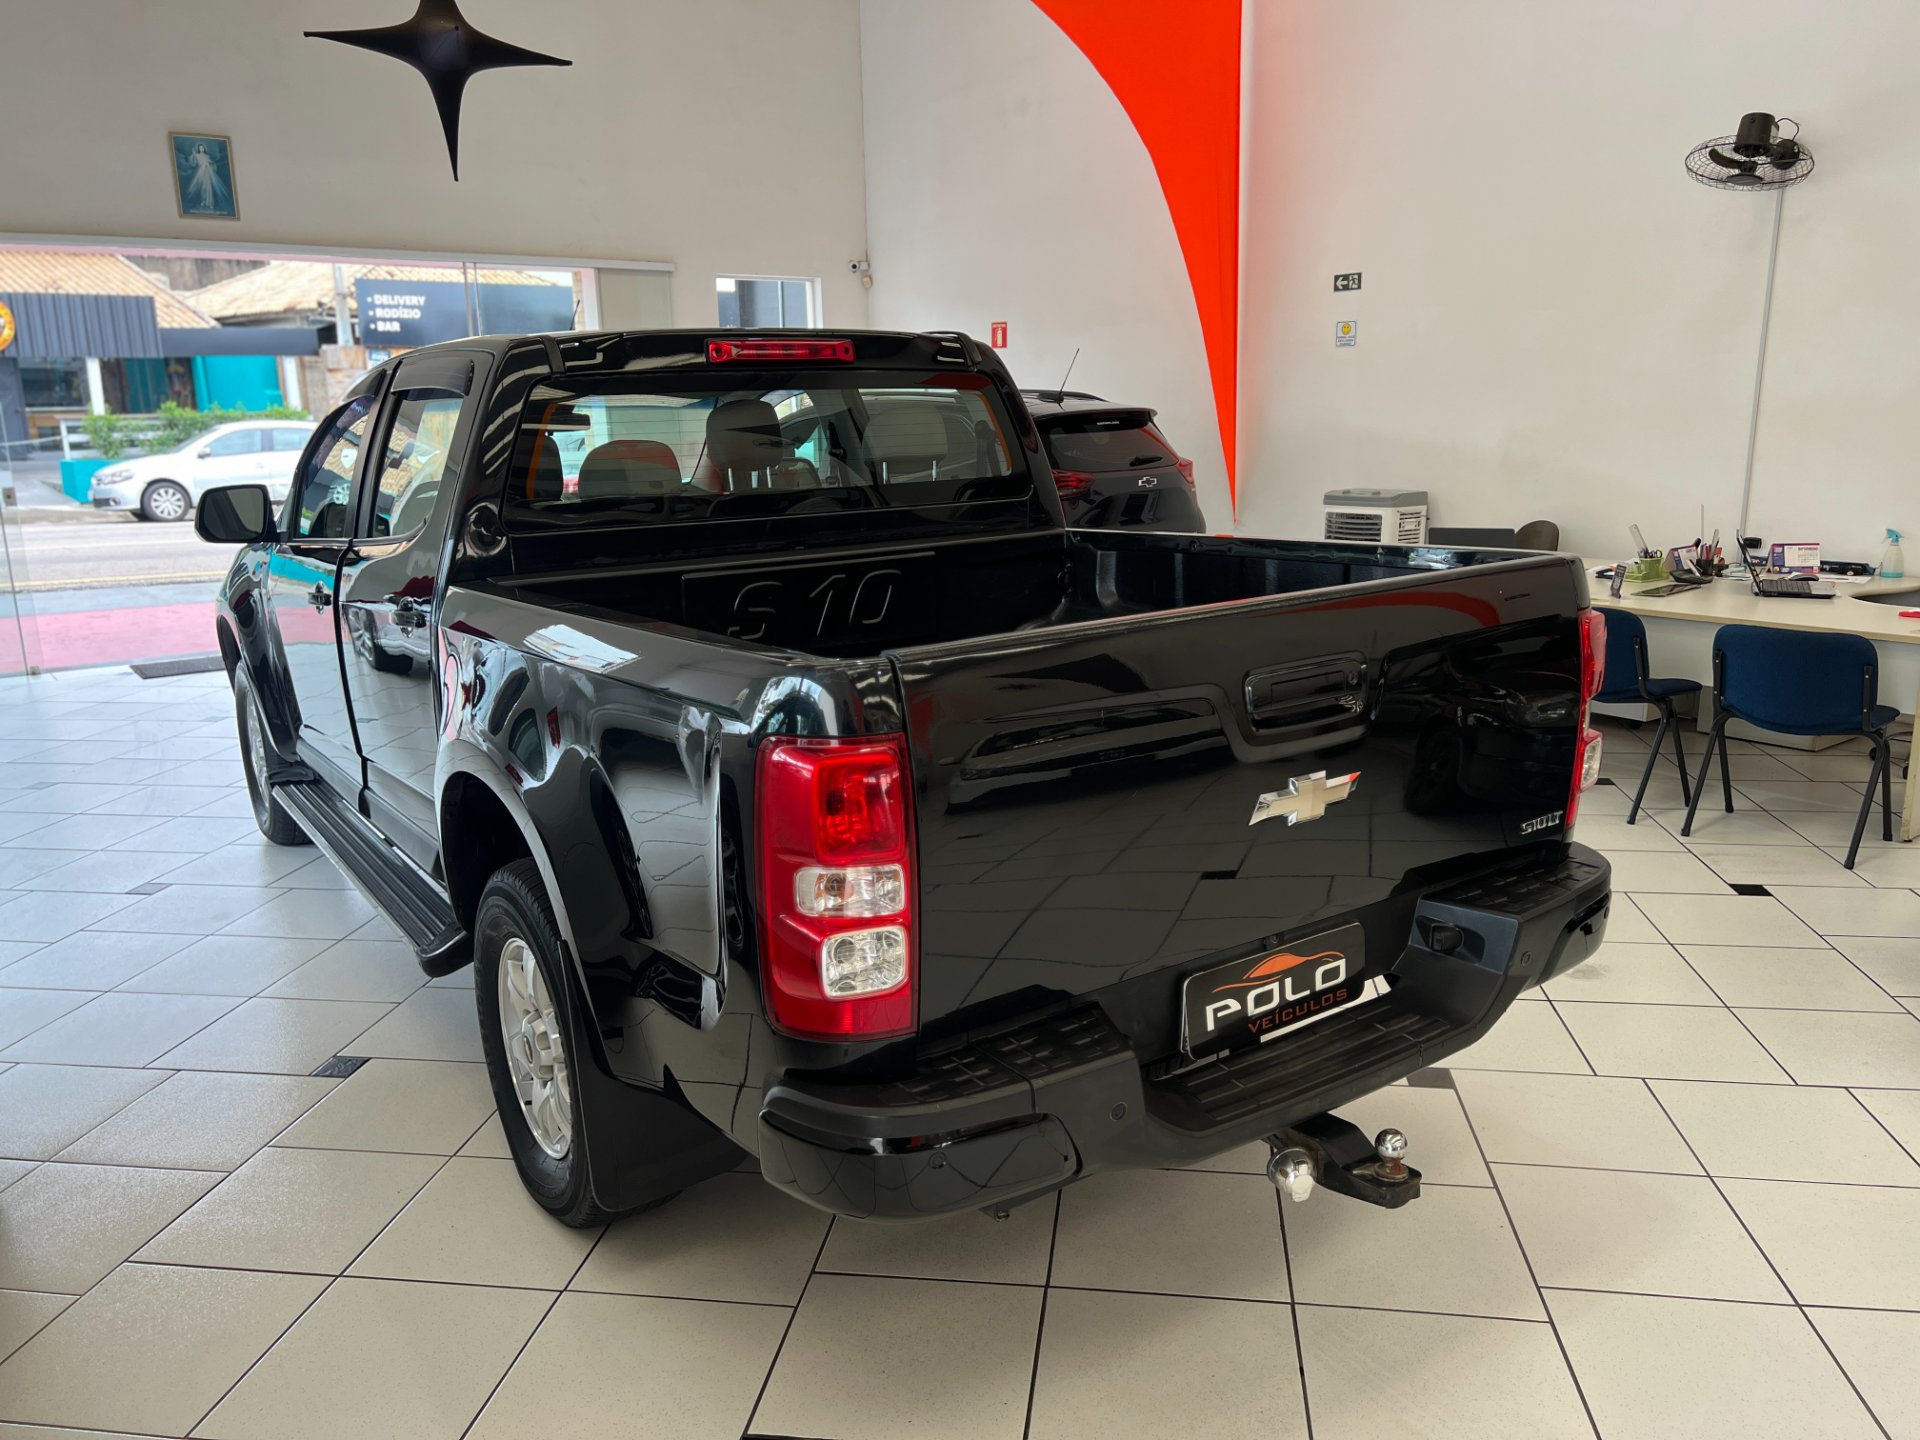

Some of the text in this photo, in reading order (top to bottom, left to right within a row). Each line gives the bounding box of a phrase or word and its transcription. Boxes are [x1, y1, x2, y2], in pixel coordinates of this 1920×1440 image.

[373, 294, 426, 306] DELIVERY
[375, 306, 421, 319] RODÍZIO
[377, 320, 401, 332] BAR
[1205, 957, 1346, 1032] POLO
[1247, 987, 1348, 1034] VEÍCULOS
